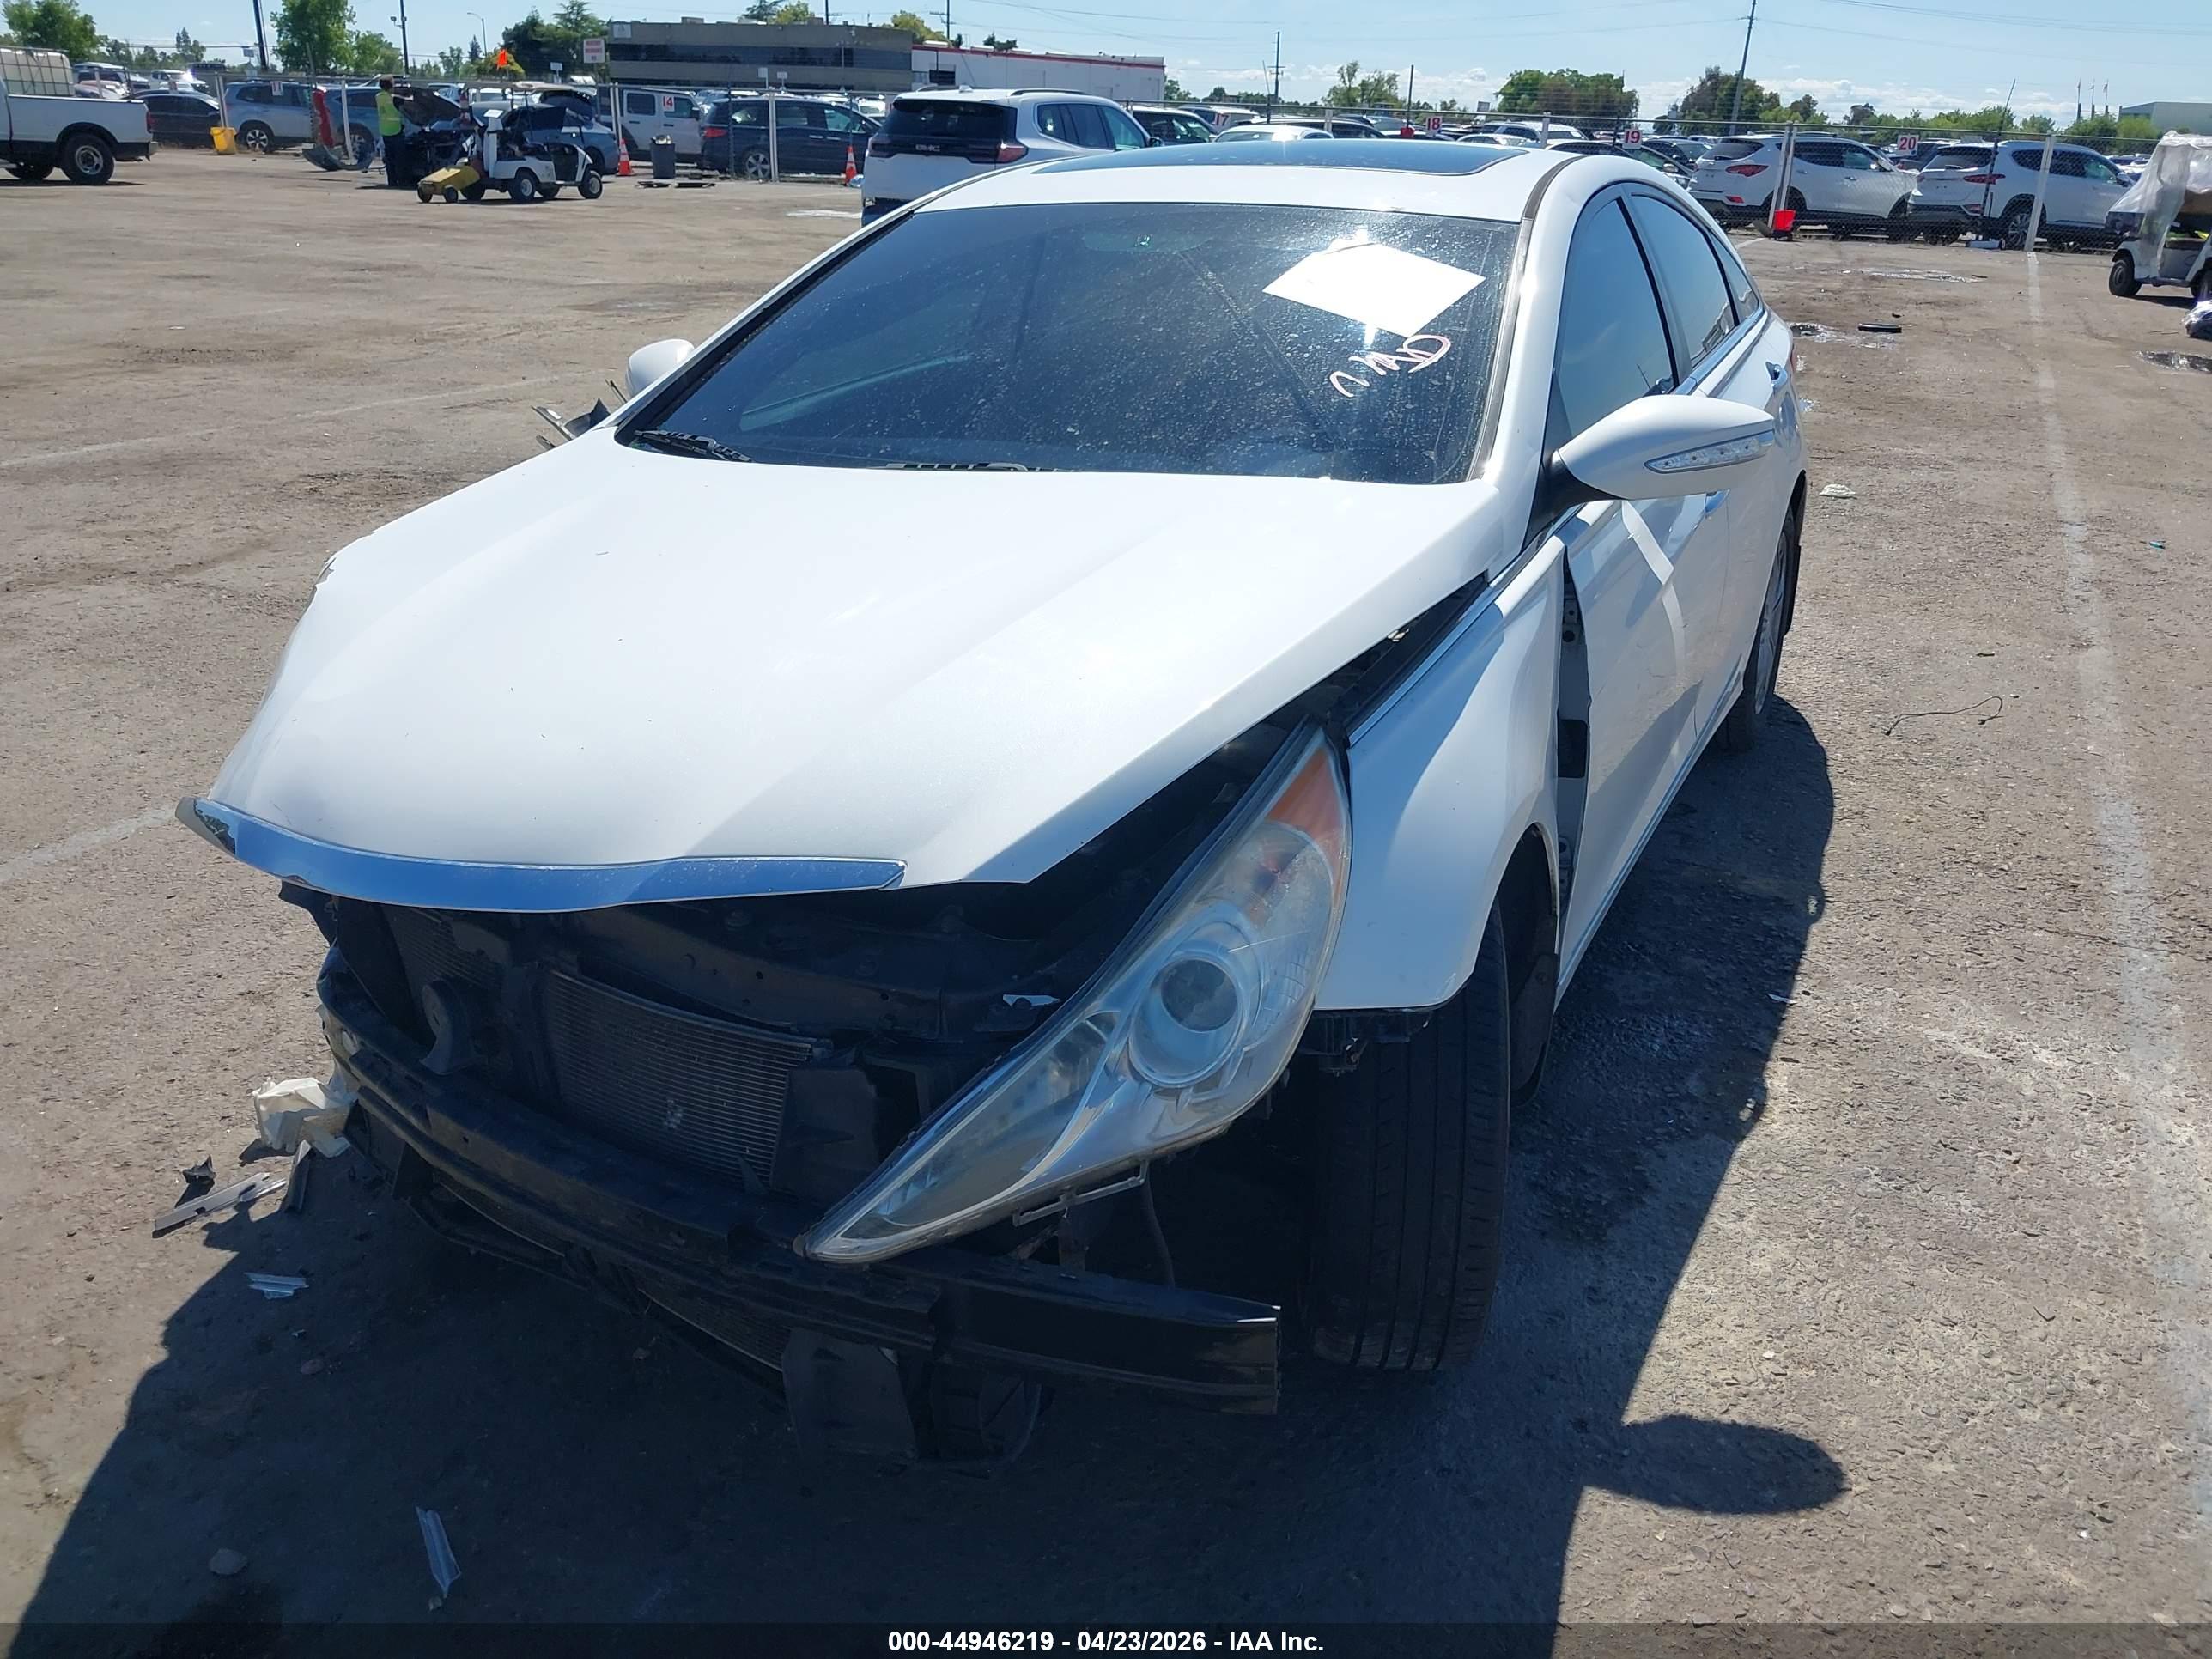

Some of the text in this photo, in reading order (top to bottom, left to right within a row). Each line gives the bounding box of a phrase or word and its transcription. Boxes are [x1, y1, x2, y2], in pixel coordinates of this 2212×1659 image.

[662, 95, 673, 107] 14
[1216, 112, 1230, 125] 17
[1427, 117, 1441, 131] 18
[1625, 130, 1641, 144] 19
[1899, 136, 1917, 151] 20
